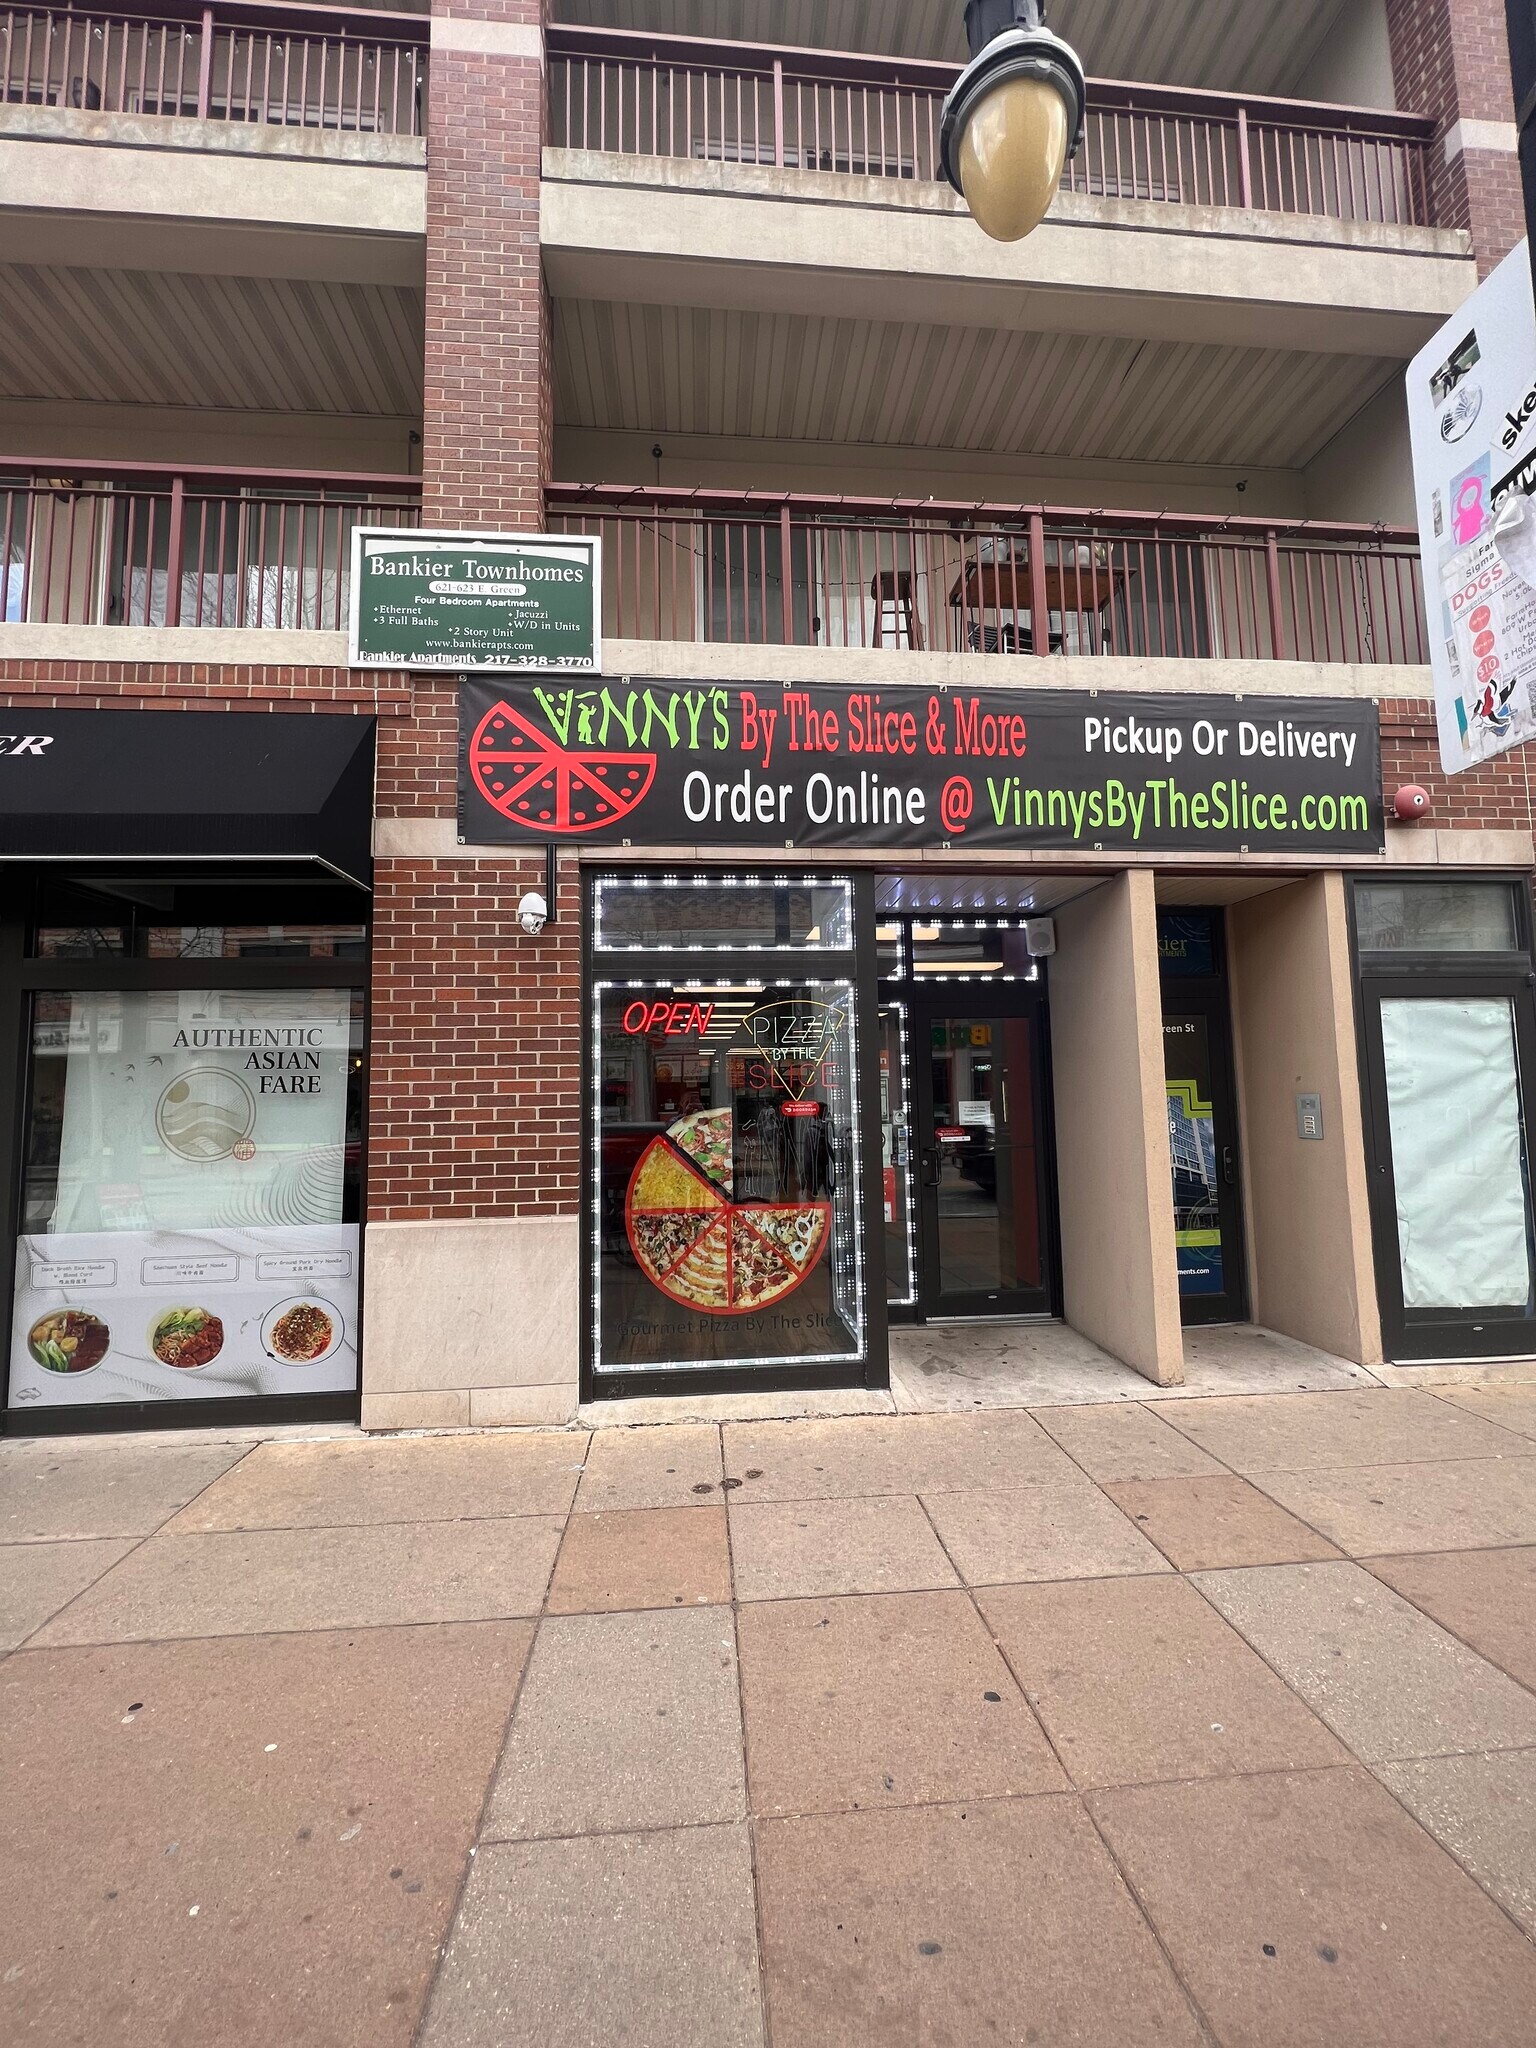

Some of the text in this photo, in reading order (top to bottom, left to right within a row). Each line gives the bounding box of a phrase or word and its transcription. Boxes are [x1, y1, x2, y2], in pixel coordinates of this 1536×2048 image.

[1501, 382, 1536, 450] ske
[370, 556, 584, 583] Bankier Townhomes
[1465, 552, 1495, 578] Sigma
[435, 583, 521, 594] 621-623 E. Green
[1452, 563, 1503, 611] DOGS
[379, 605, 421, 615] Ethernet
[414, 595, 540, 609] Four Bedroom Apartments
[379, 616, 439, 626] 3 Full Baths
[514, 609, 548, 620] Jacuzzi
[453, 627, 514, 638] 2 Story Unit
[513, 620, 580, 632] W/D in Units
[1501, 623, 1516, 636] 809
[1517, 614, 1526, 625] W
[426, 638, 534, 651] www.bankierapts.com
[1511, 643, 1526, 656] Hot
[359, 651, 593, 667] Bankier Apartments 217-328-3770
[1477, 658, 1497, 678] $10
[741, 691, 777, 768] By
[784, 692, 839, 752] The
[848, 694, 918, 755] Slice
[925, 695, 946, 755] &
[954, 697, 1027, 757] More
[1084, 716, 1357, 767] Pickup Or Delivery
[683, 769, 1369, 839] Order Online @ VinnysByTheSlice.com
[623, 1001, 715, 1034] OPEN
[753, 1015, 838, 1044] PIZZA
[1185, 1023, 1196, 1033] St
[172, 1028, 324, 1048] AUTHENTIC
[243, 1051, 321, 1070] ASIAN
[772, 1046, 818, 1061] BY THE
[259, 1075, 322, 1094] FARE
[749, 1062, 839, 1089] SLICE
[616, 1319, 693, 1337] Gourmet
[699, 1318, 740, 1333] Pizza
[746, 1316, 765, 1334] By
[771, 1314, 801, 1330] The
